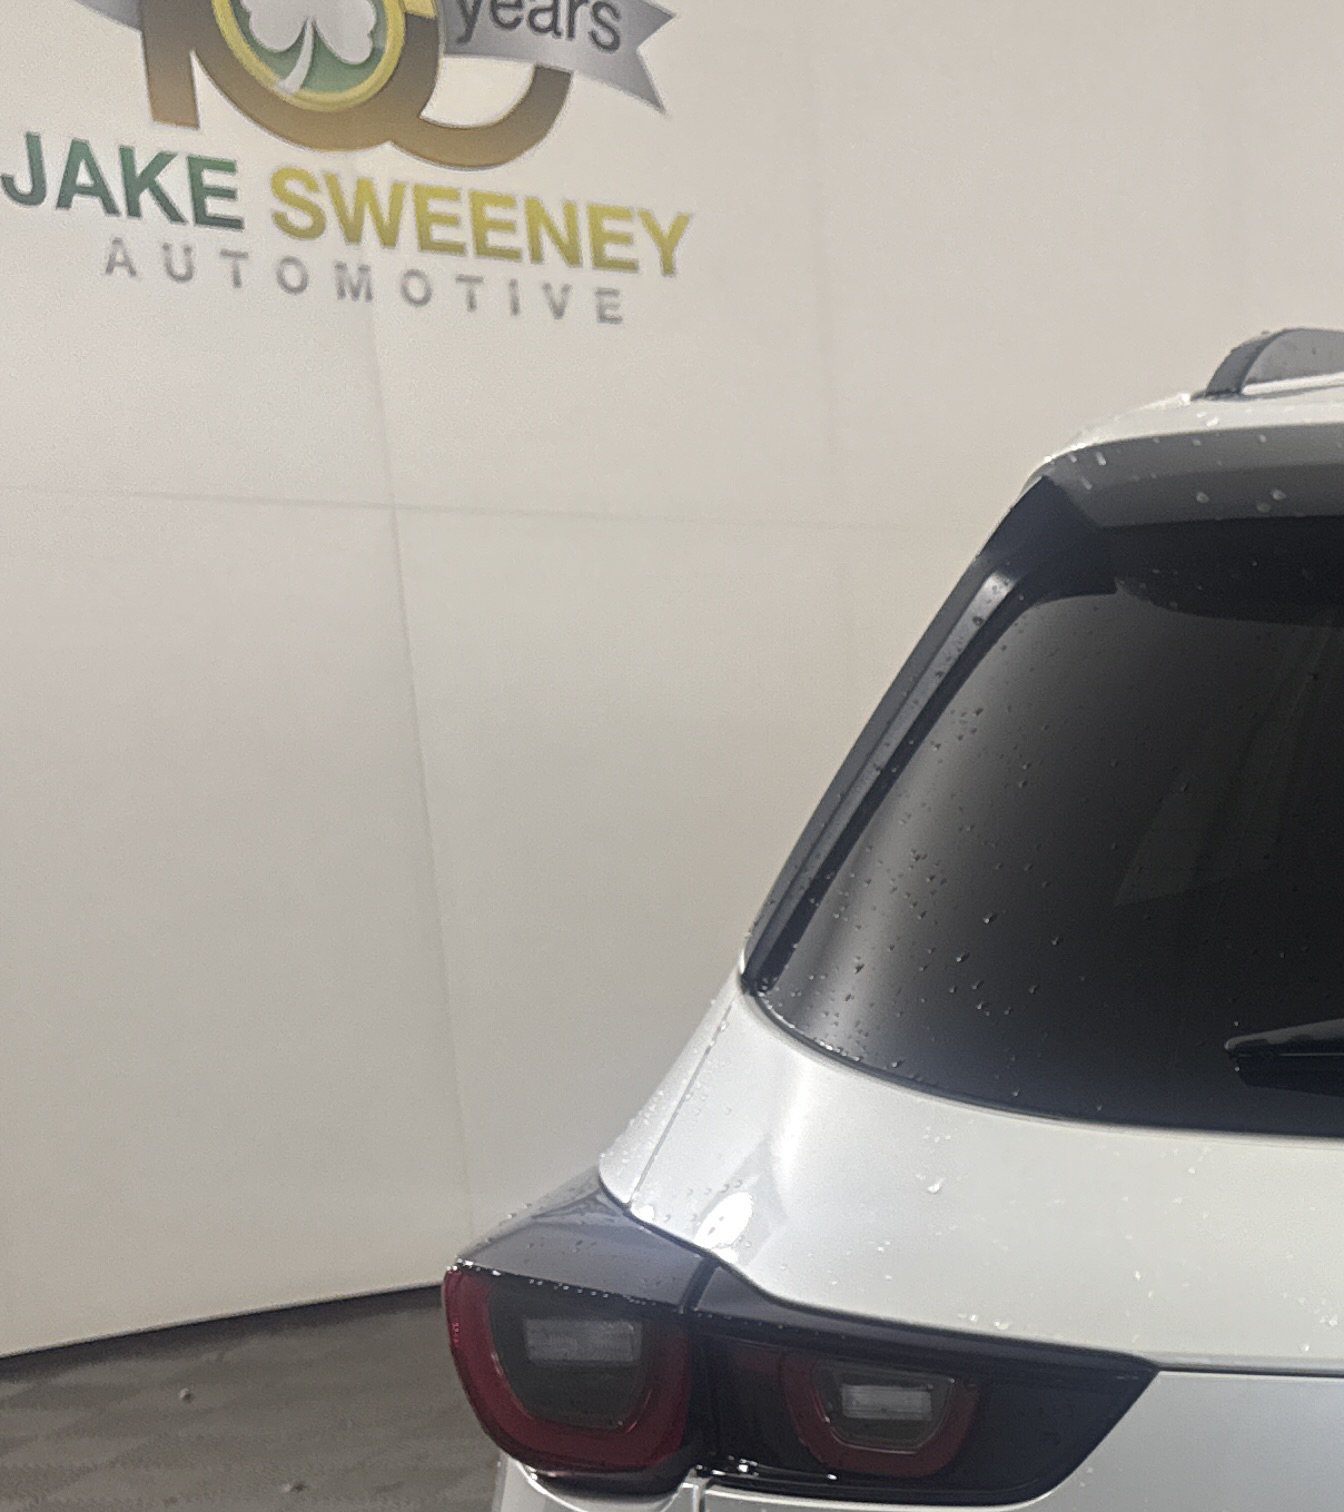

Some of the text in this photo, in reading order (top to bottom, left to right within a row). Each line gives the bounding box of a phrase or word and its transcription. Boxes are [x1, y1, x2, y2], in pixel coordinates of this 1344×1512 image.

[1, 131, 693, 278] JAKE SWEENEY
[105, 237, 625, 325] AUTOMOTIVE
